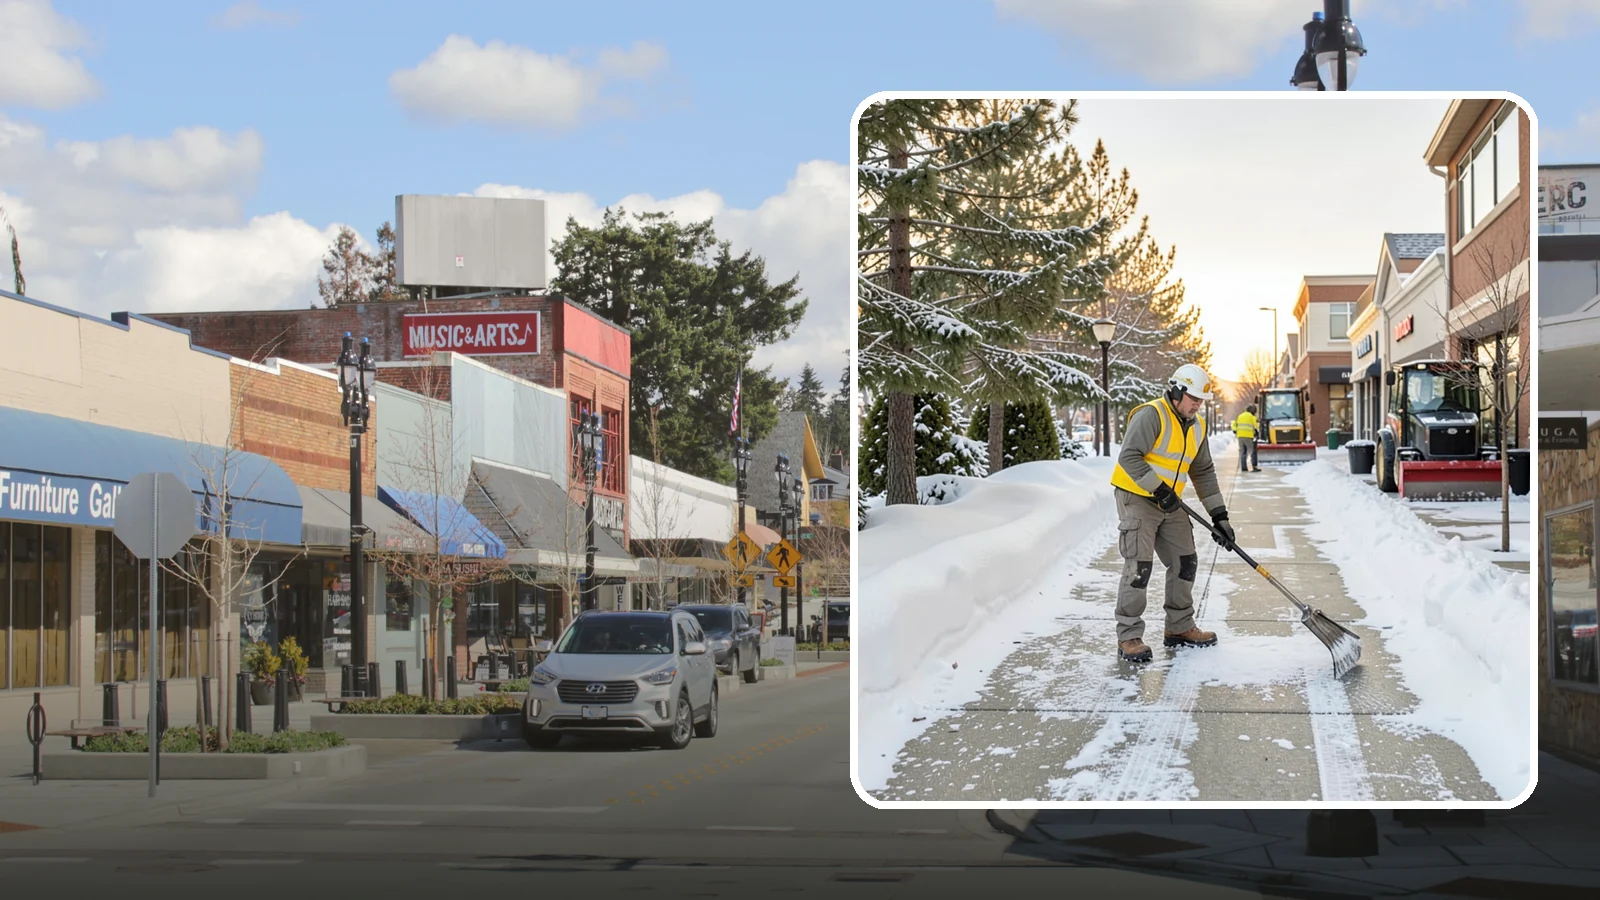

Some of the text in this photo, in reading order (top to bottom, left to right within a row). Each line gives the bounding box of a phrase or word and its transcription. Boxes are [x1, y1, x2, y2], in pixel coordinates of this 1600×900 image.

[1540, 427, 1578, 436] UGA
[0, 471, 122, 519] Furniture Gal
[454, 563, 479, 574] SUSHI
